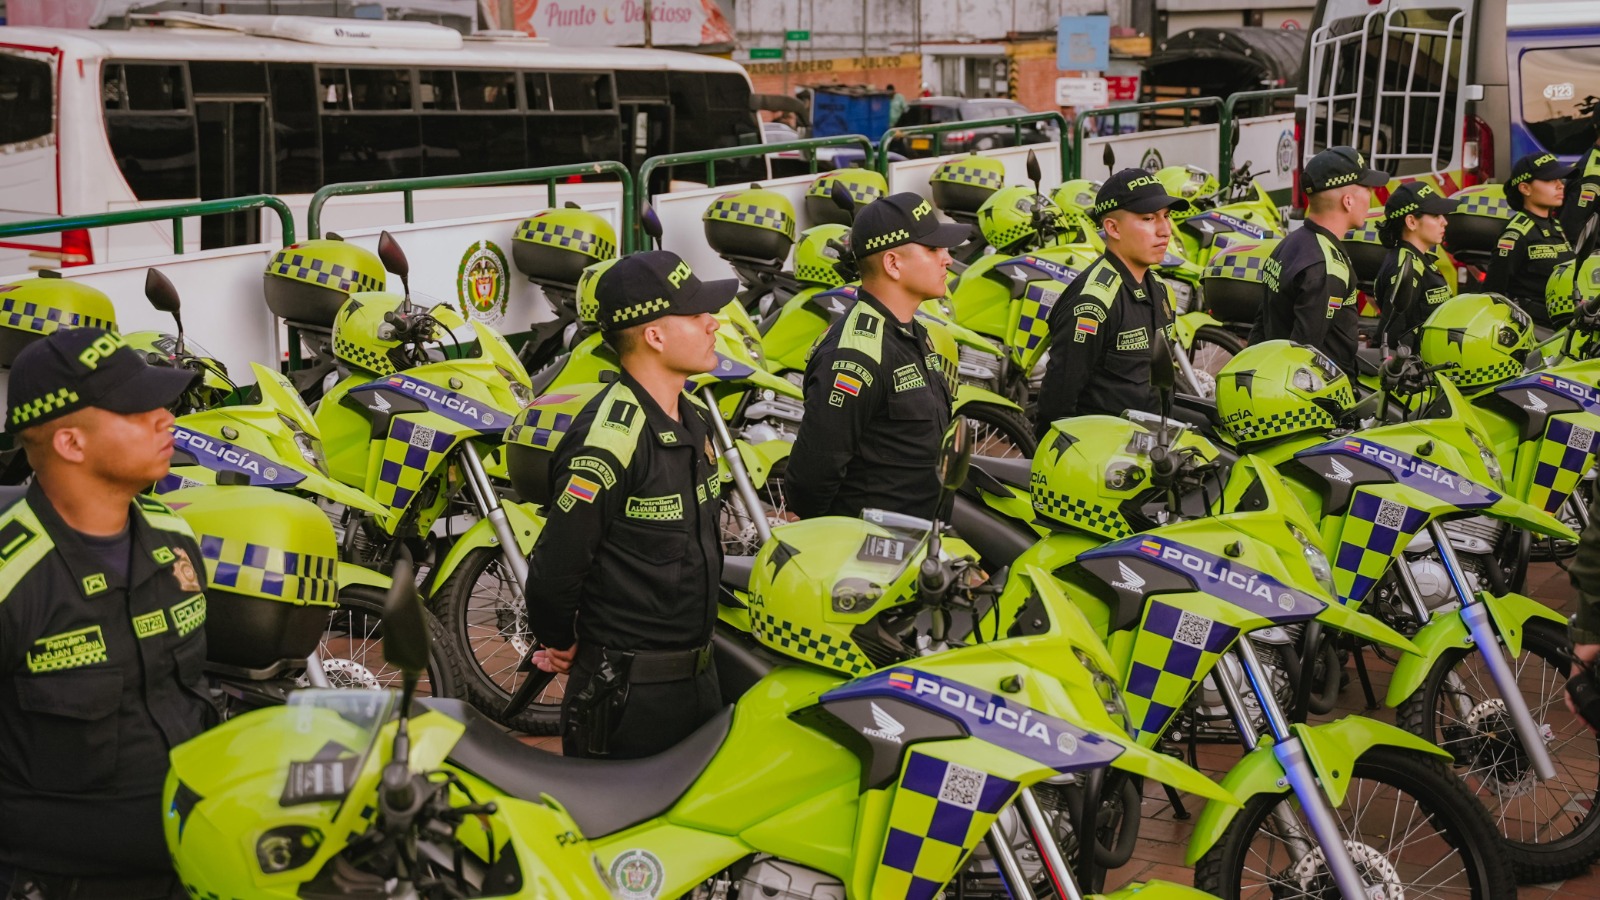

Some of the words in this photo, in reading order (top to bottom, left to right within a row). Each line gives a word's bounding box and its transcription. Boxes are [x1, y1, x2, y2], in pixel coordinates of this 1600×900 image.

[545, 2, 596, 27] Punto
[621, 2, 692, 24] Decioso
[1553, 85, 1571, 97] 123
[1220, 214, 1263, 236] POLICÍA
[402, 380, 478, 419] POLICÍA
[174, 429, 259, 475] POLICÍA
[1362, 444, 1455, 489] POLICÍA
[1324, 473, 1352, 484] HONDA
[631, 505, 657, 513] ALVARO
[1162, 546, 1274, 603] POLICÍA
[1111, 581, 1144, 594] HONDA
[33, 648, 71, 663] JHOJAN
[73, 641, 101, 655] BERNA
[46, 635, 87, 651] Patrullero
[915, 677, 1051, 745] POLICÍA
[863, 727, 902, 744] HONDA
